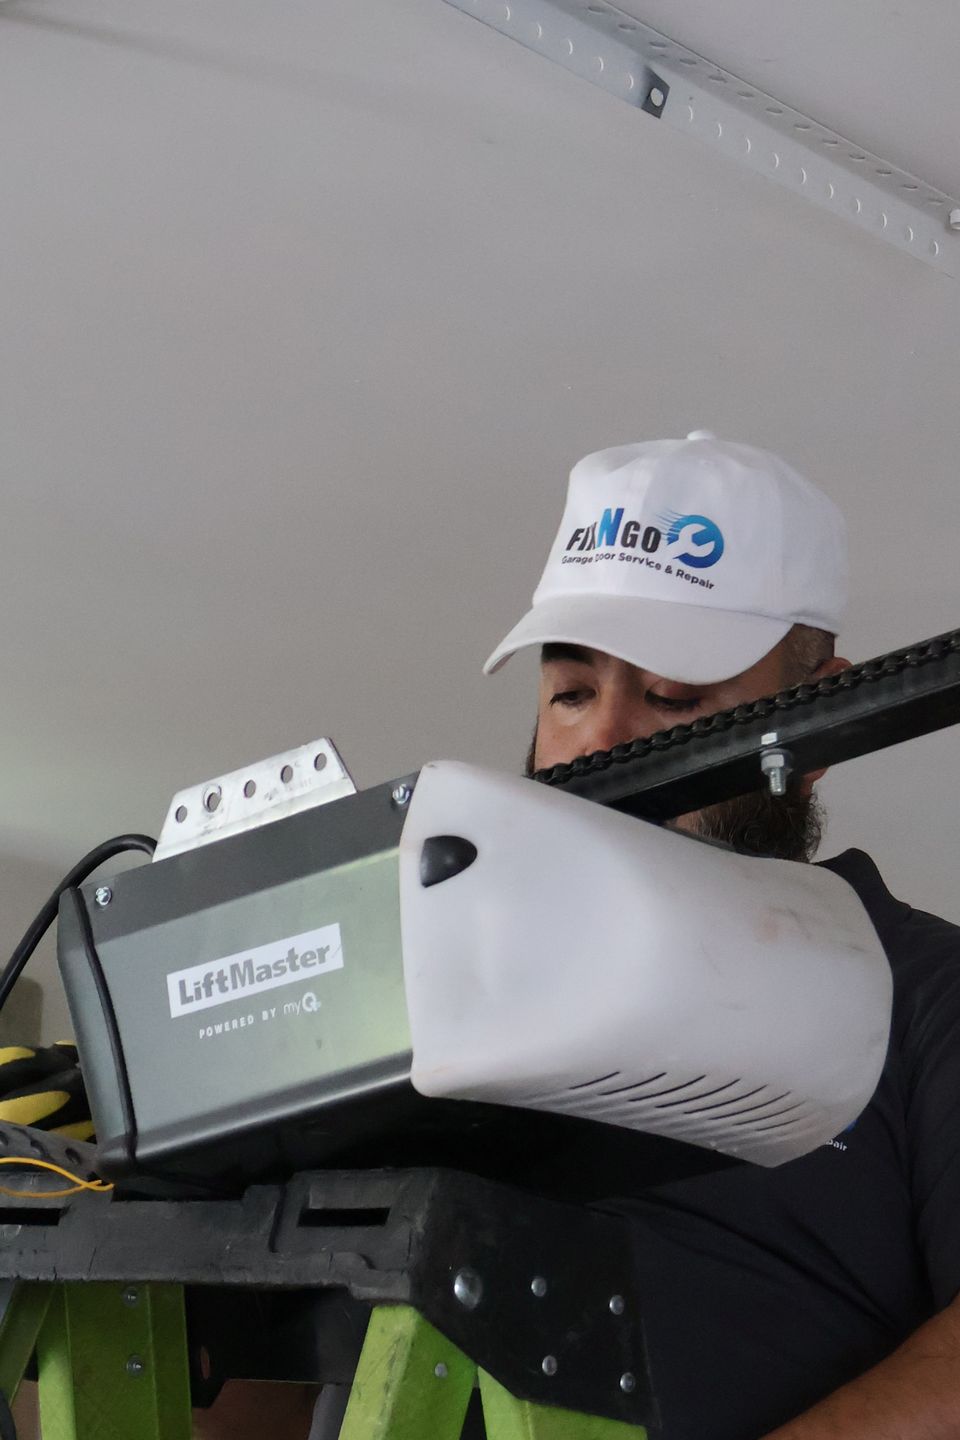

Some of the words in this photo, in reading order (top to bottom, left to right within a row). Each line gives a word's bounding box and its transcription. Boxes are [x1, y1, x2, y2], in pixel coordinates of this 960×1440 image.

[562, 555, 593, 565] Garage
[618, 552, 662, 571] Service
[664, 565, 673, 575] &
[675, 568, 715, 590] Repair
[178, 944, 331, 1006] LiftMaster
[199, 1013, 255, 1040] POWERED
[262, 1007, 277, 1021] BY
